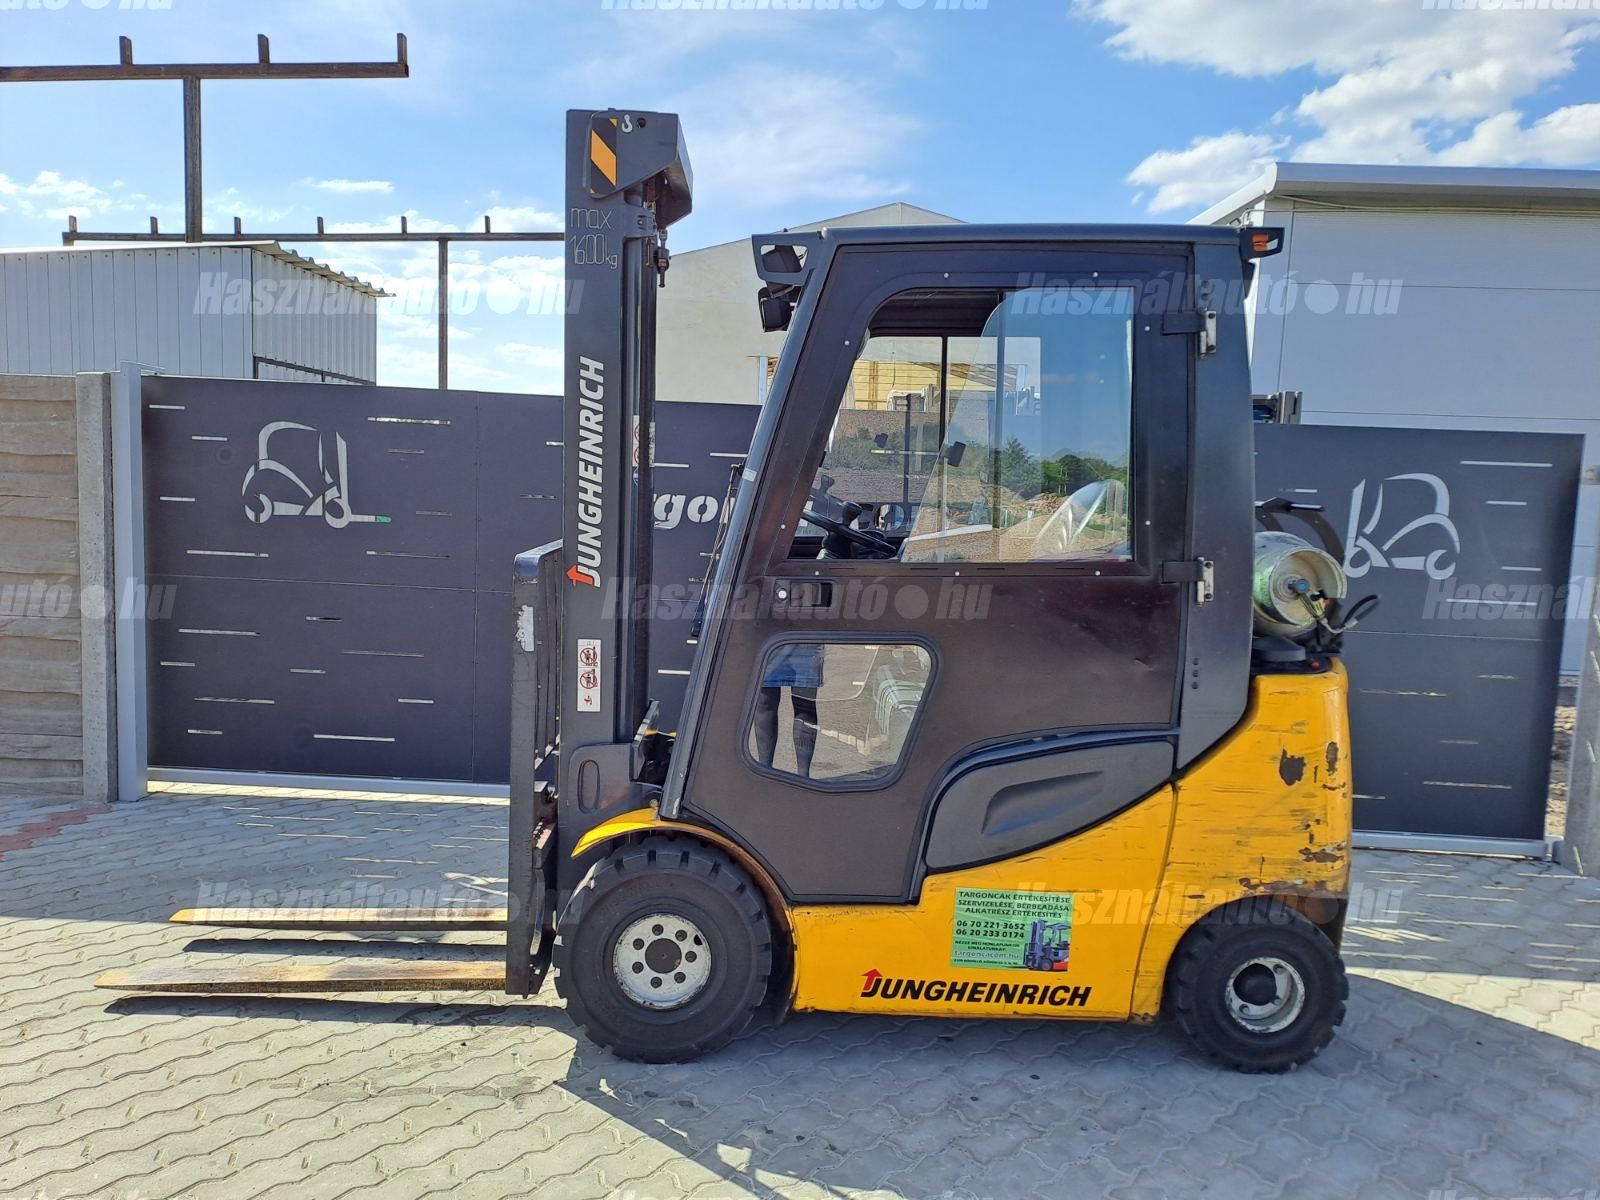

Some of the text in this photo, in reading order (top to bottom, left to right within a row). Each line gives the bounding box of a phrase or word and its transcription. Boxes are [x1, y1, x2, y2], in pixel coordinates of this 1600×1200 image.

[575, 355, 605, 588] JUNGHEINRICH
[955, 928, 1025, 939] 06 20 233 0174
[956, 920, 1026, 930] 06 70 221 3652
[860, 977, 1092, 1007] JUNGHEINRICH
